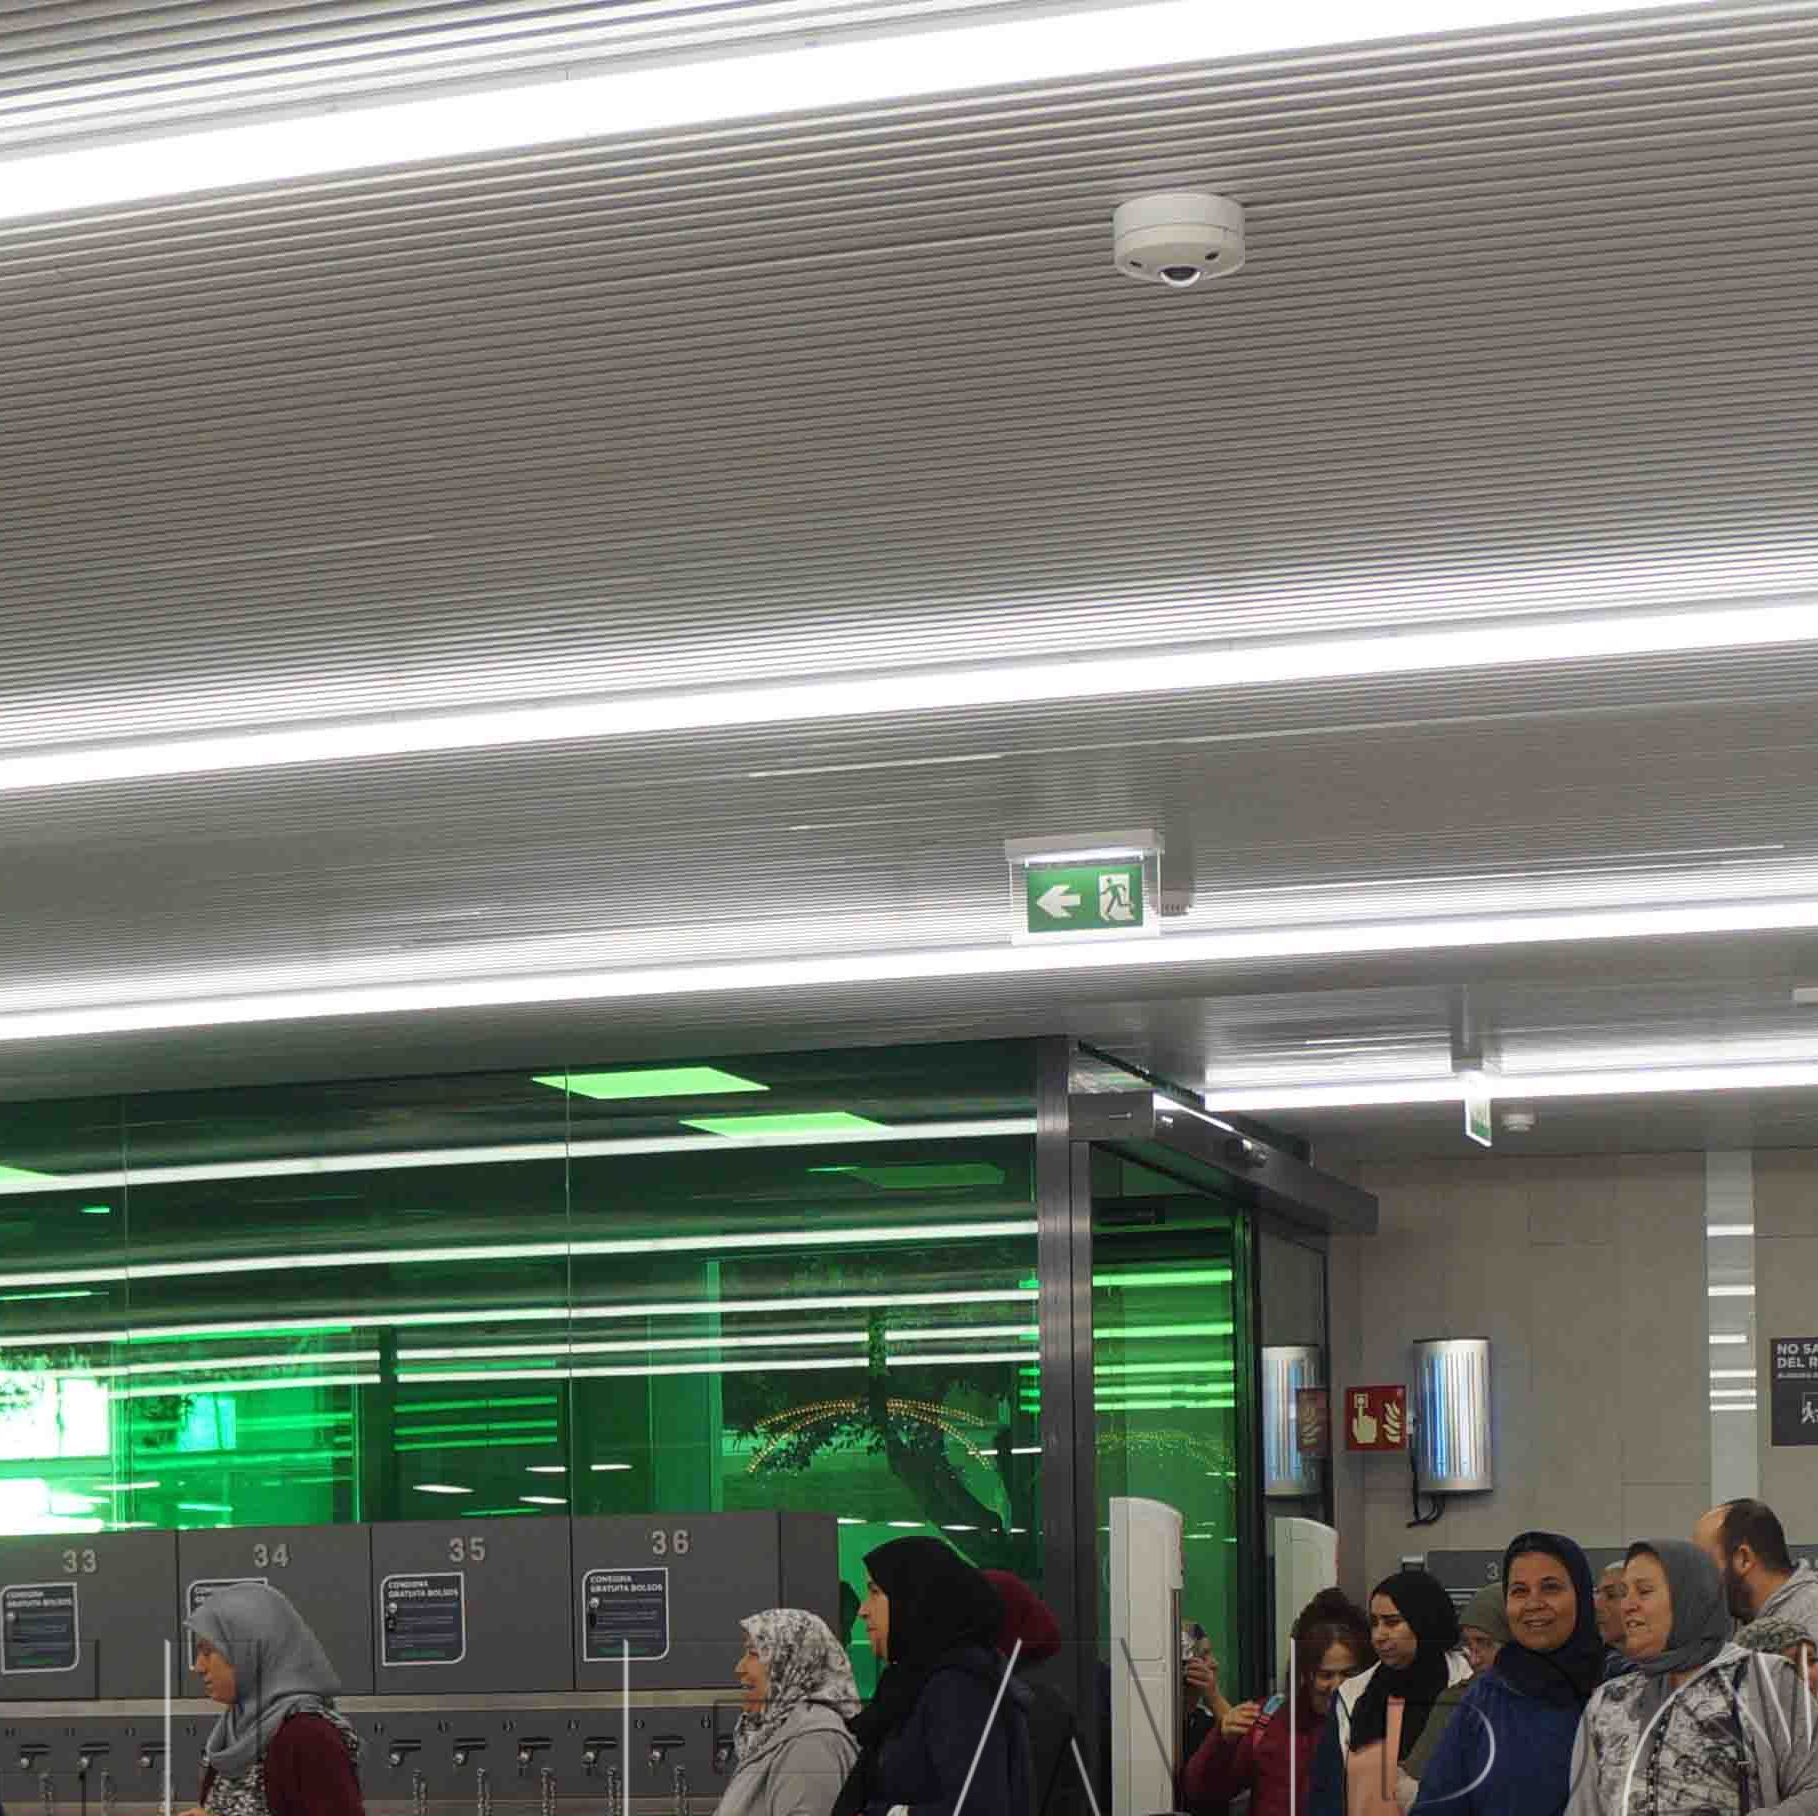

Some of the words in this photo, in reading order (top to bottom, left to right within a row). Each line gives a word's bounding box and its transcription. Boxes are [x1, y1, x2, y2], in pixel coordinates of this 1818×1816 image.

[1776, 1343, 1799, 1355] NO
[1776, 1356, 1806, 1369] DEL
[448, 1537, 485, 1561] 35
[651, 1529, 690, 1554] 36
[62, 1549, 97, 1573] 33
[253, 1543, 288, 1569] 34
